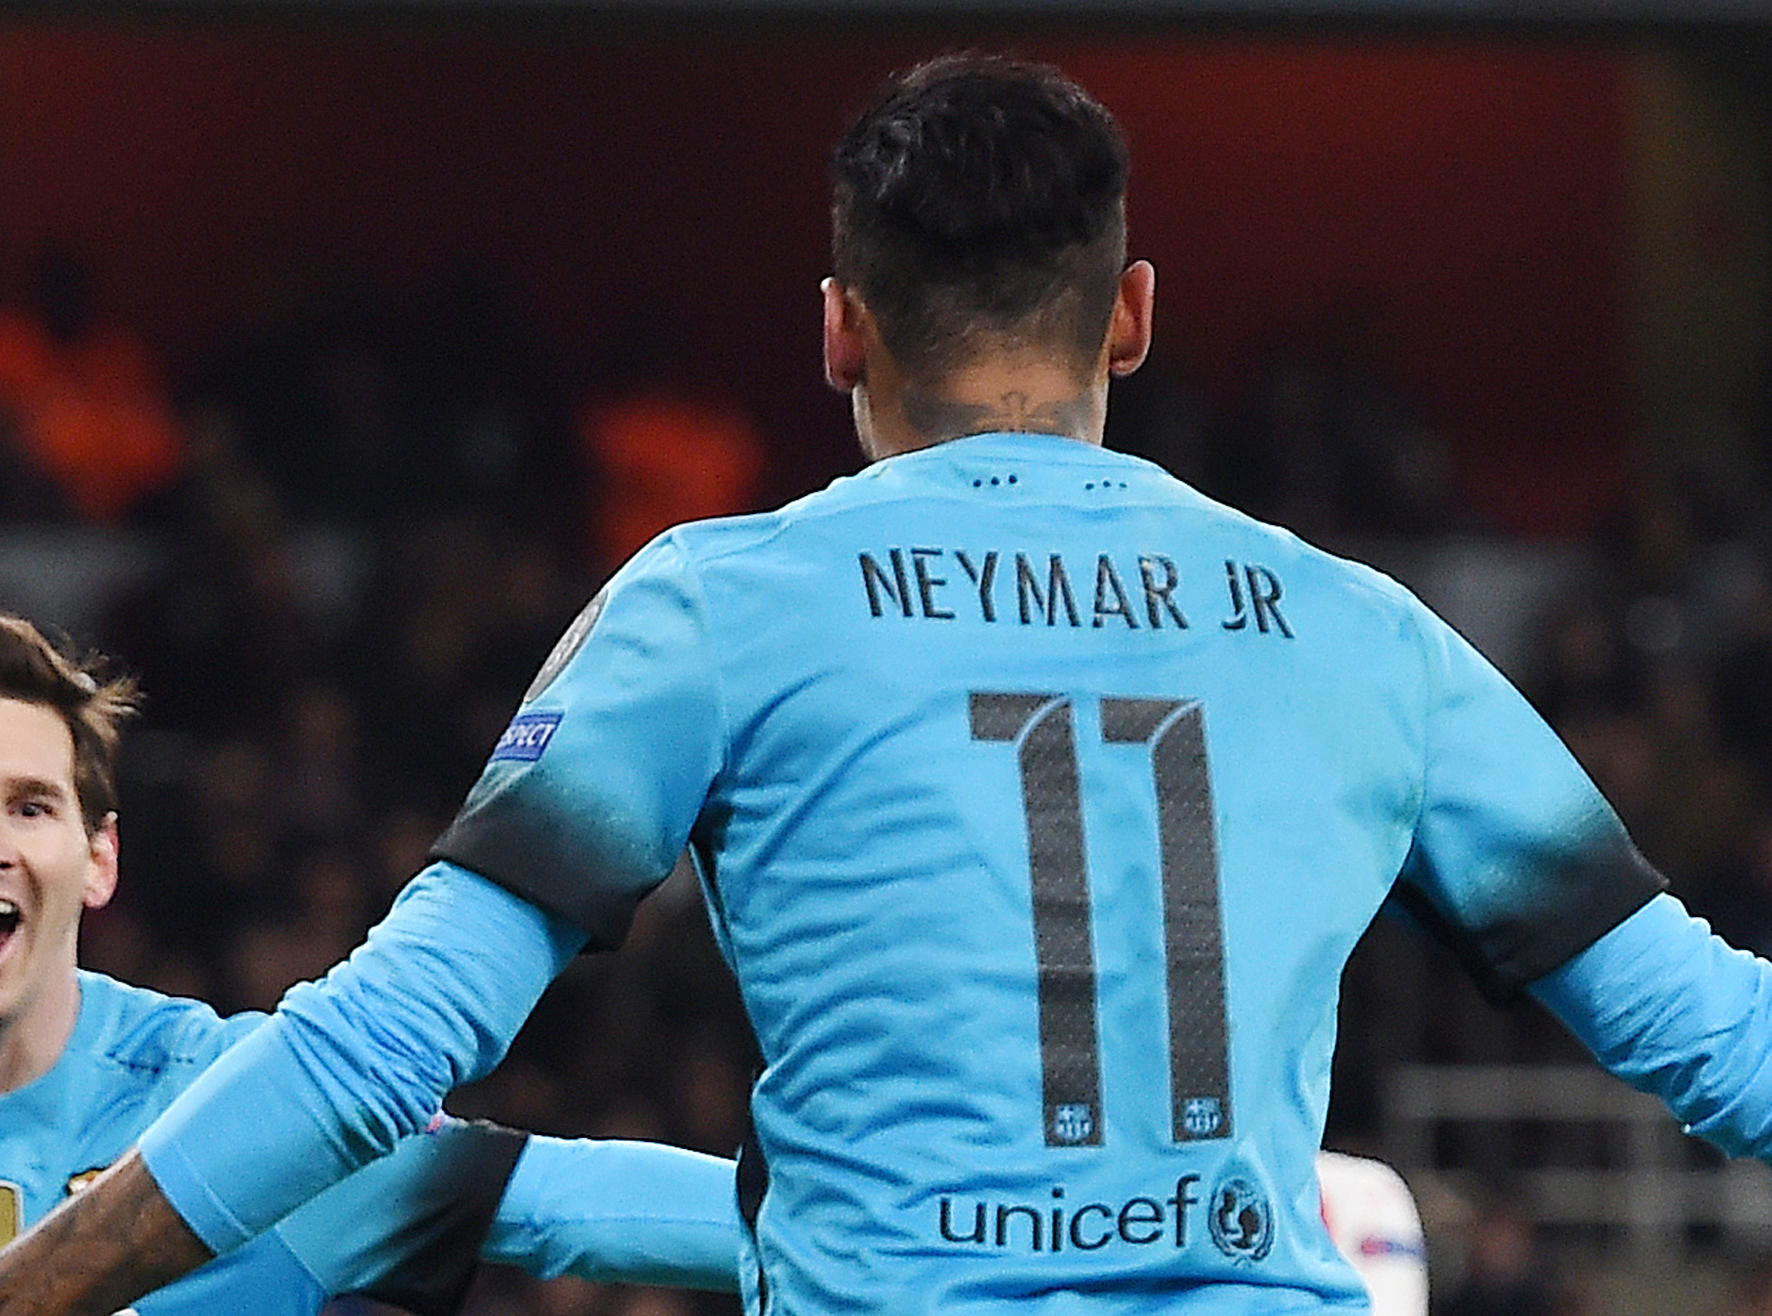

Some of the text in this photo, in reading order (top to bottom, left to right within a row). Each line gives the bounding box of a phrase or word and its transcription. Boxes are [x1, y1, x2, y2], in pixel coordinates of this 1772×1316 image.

[858, 547, 1296, 639] NEYMAR JR
[968, 692, 1234, 1148] 11
[938, 1174, 1200, 1252] unicef
